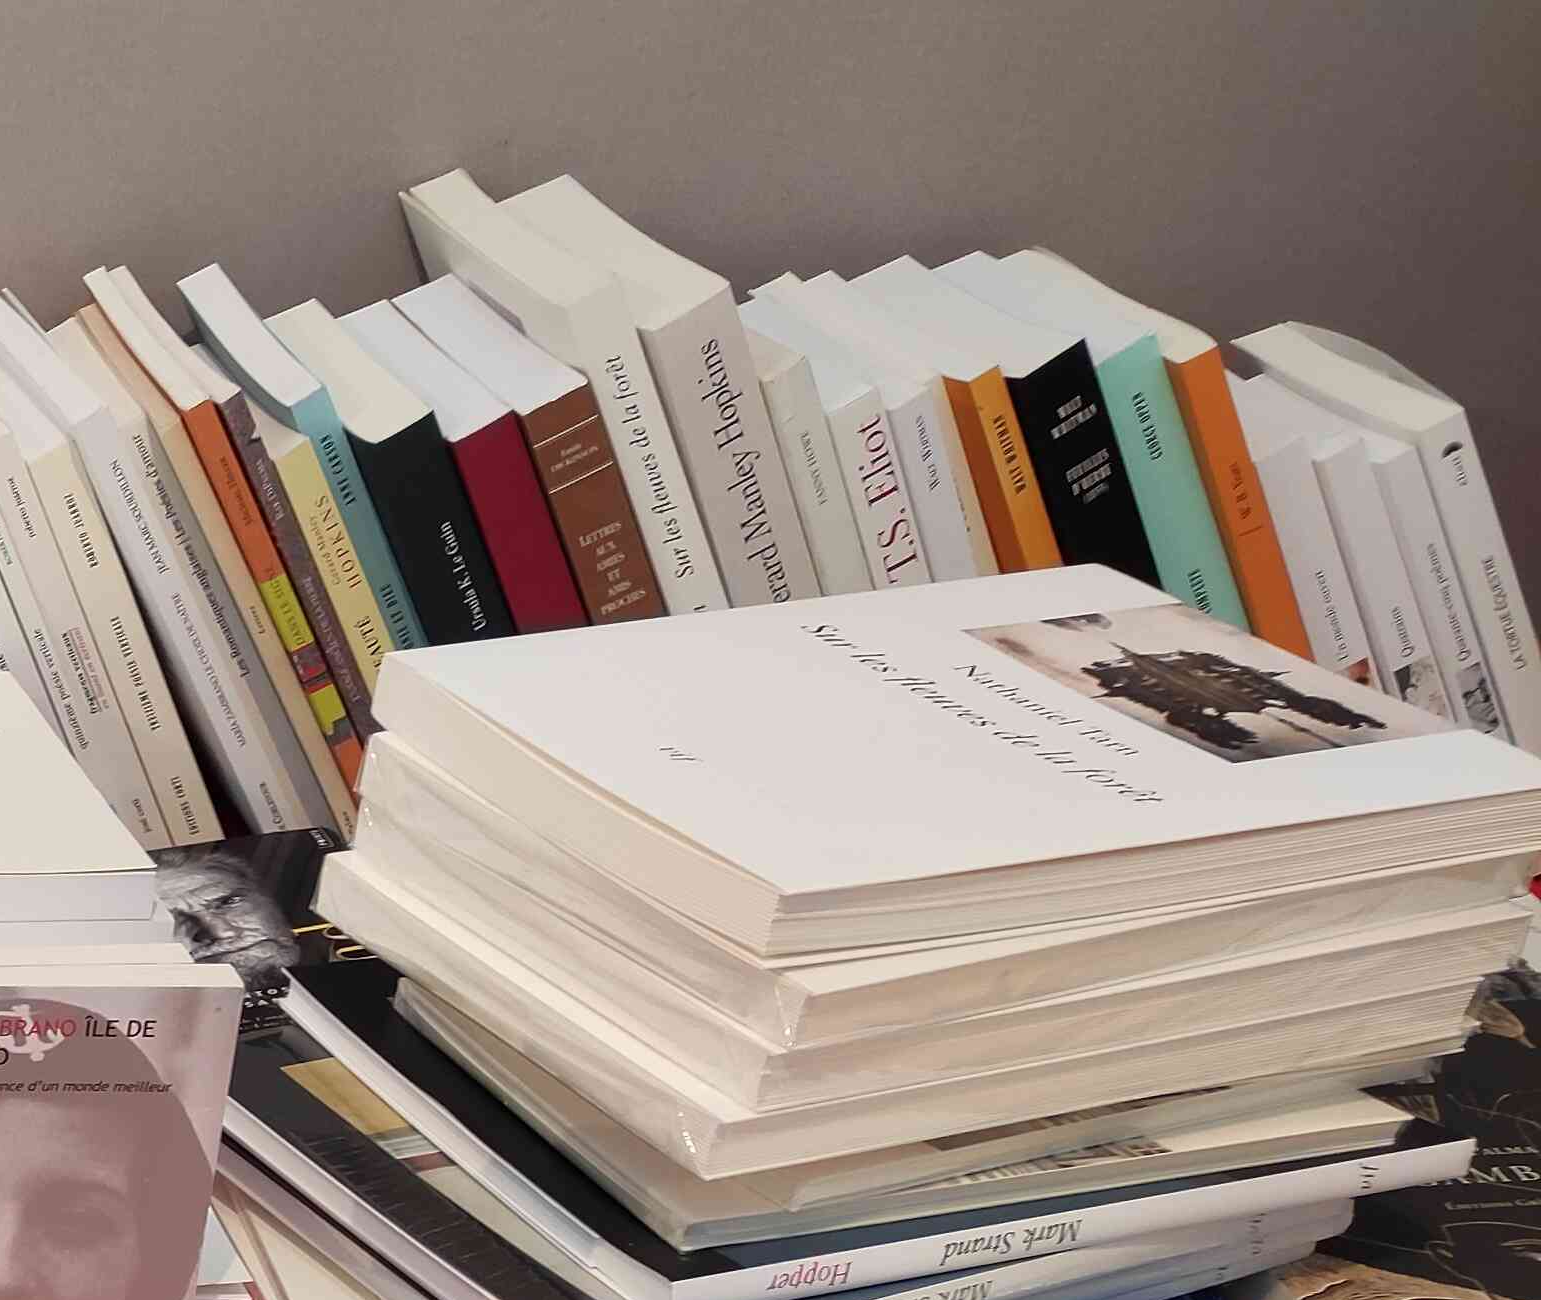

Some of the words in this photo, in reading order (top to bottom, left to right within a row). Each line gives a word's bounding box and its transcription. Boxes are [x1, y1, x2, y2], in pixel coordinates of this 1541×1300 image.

[606, 356, 637, 400] forêt
[683, 334, 758, 452] Hopkins
[622, 405, 641, 424] la
[625, 424, 652, 450] de
[134, 436, 159, 477] d'amour
[841, 412, 905, 507] Eliot
[156, 480, 177, 519] Poésies
[644, 454, 676, 514] fleuves
[715, 445, 785, 544] Manley
[136, 520, 158, 550] MARC
[168, 516, 187, 539] Les
[319, 496, 361, 587] HOPKINS
[434, 520, 462, 556] Guin
[663, 518, 682, 544] les
[151, 550, 169, 574] JEAN
[180, 541, 214, 594] anglaises
[447, 554, 467, 573] Le
[666, 544, 696, 579] Sur
[748, 544, 790, 603] erard
[458, 572, 471, 589] K.
[207, 593, 241, 658] Romantiques
[464, 589, 486, 630] Ursula
[232, 658, 246, 678] Les
[84, 1016, 119, 1037] ÎLE
[126, 1020, 156, 1037] DE
[28, 1080, 60, 1092] d'un
[63, 1080, 109, 1092] monde
[112, 1081, 172, 1093] meilleur
[941, 1231, 1016, 1265] Strand
[1022, 1218, 1085, 1252] Mark
[767, 1261, 852, 1291] Hopper
